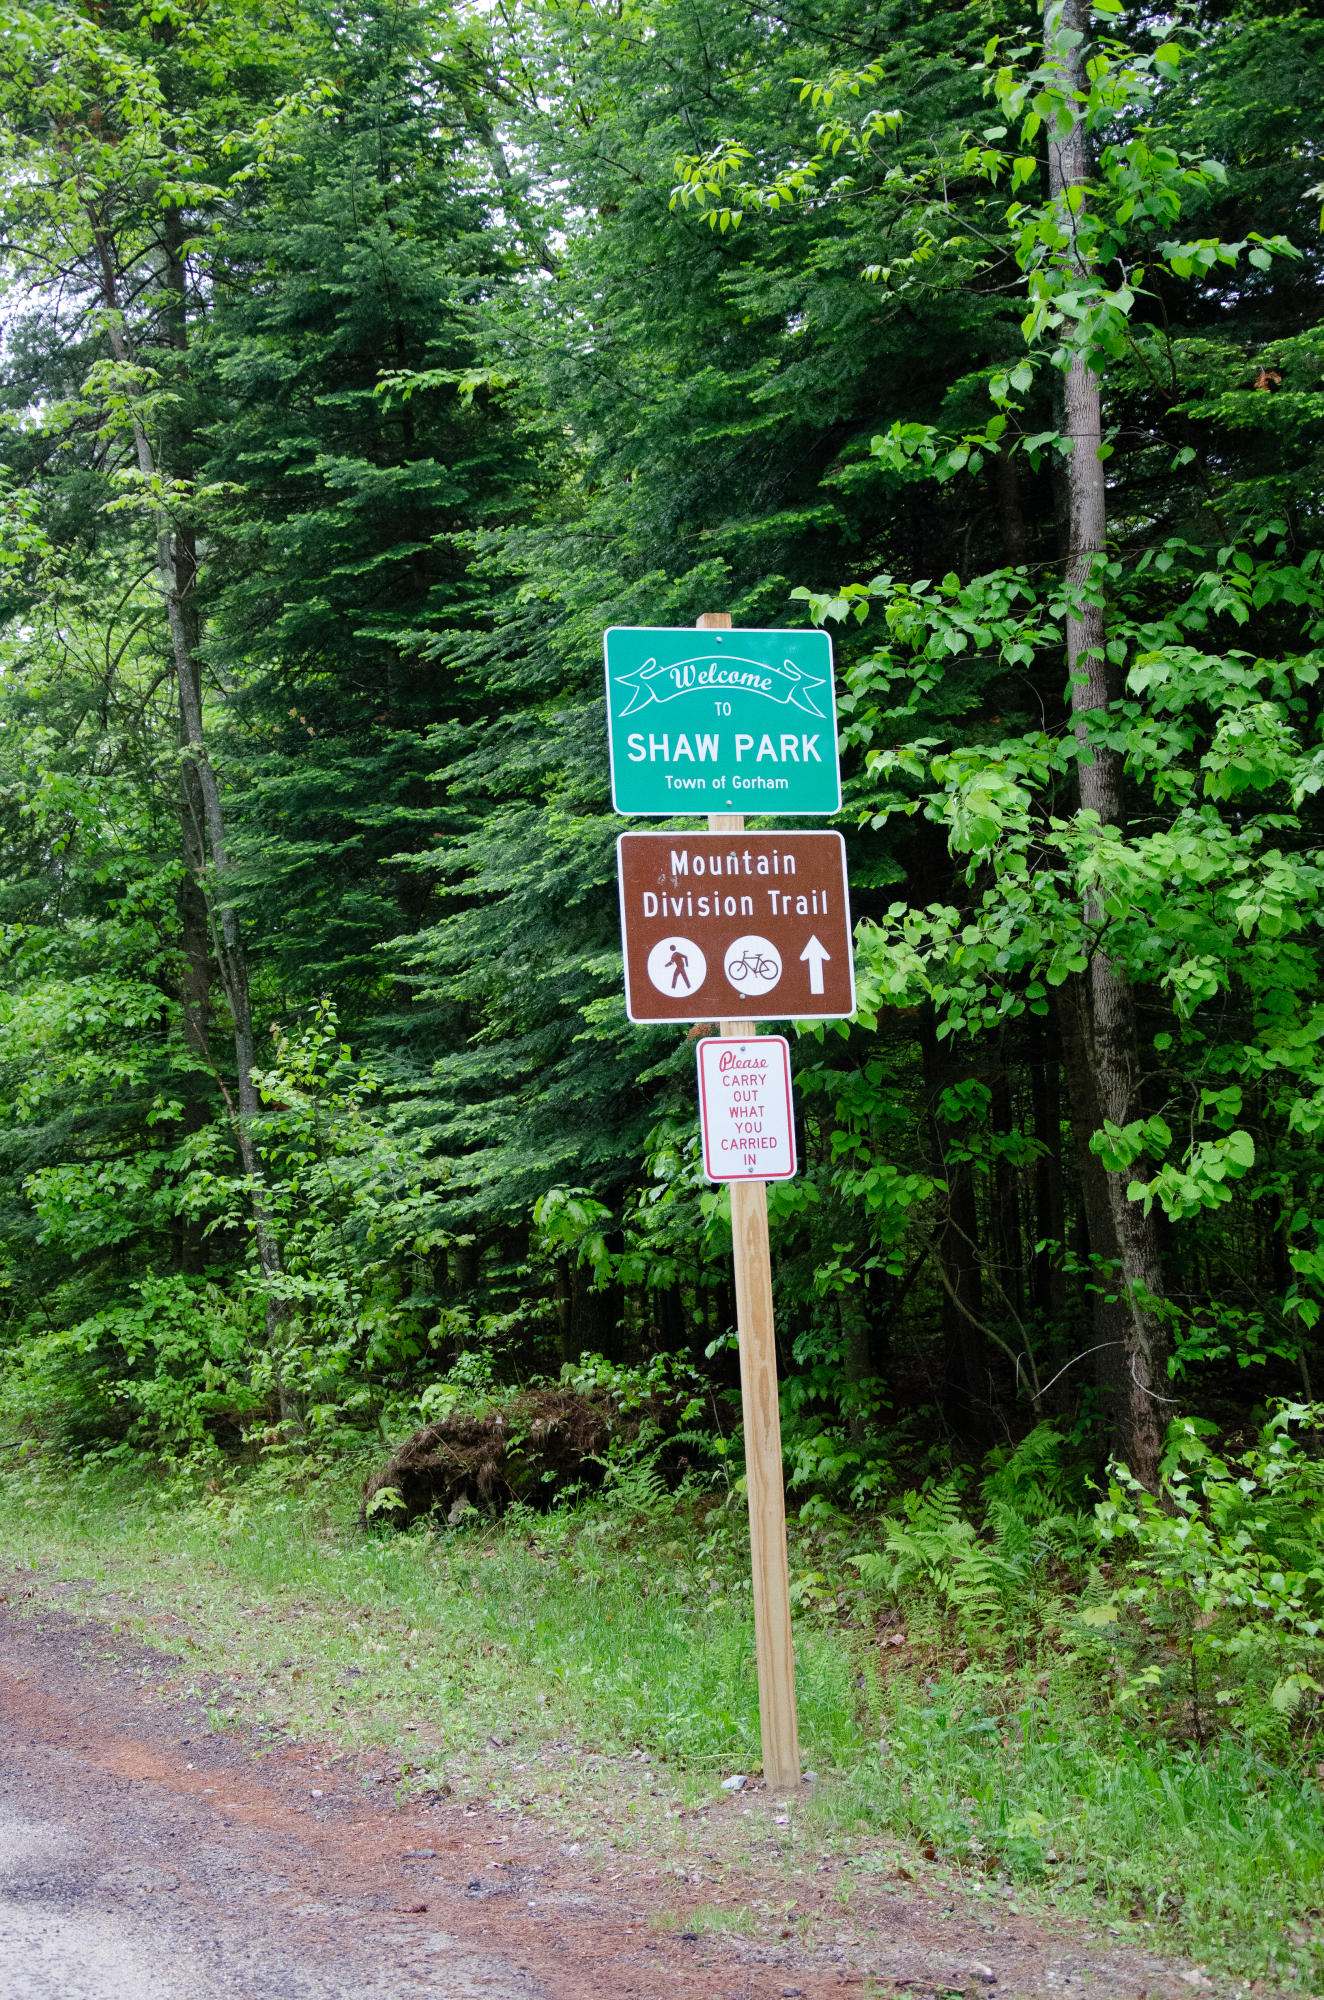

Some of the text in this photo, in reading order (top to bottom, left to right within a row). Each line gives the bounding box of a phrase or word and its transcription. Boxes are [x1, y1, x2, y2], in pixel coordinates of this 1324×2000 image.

[670, 662, 772, 691] Welcome
[714, 702, 731, 716] TO
[627, 733, 822, 762] SHAW PARK
[665, 775, 789, 789] Town of Gorham
[670, 850, 796, 876] Mountain
[643, 889, 828, 918] Division Trail
[719, 1050, 769, 1072] Please
[722, 1074, 767, 1087] CARRY
[733, 1090, 758, 1102] OUT
[729, 1105, 765, 1118] WHAT
[734, 1121, 762, 1134] YOU
[721, 1137, 777, 1150] CARRIED
[744, 1153, 757, 1165] IN
